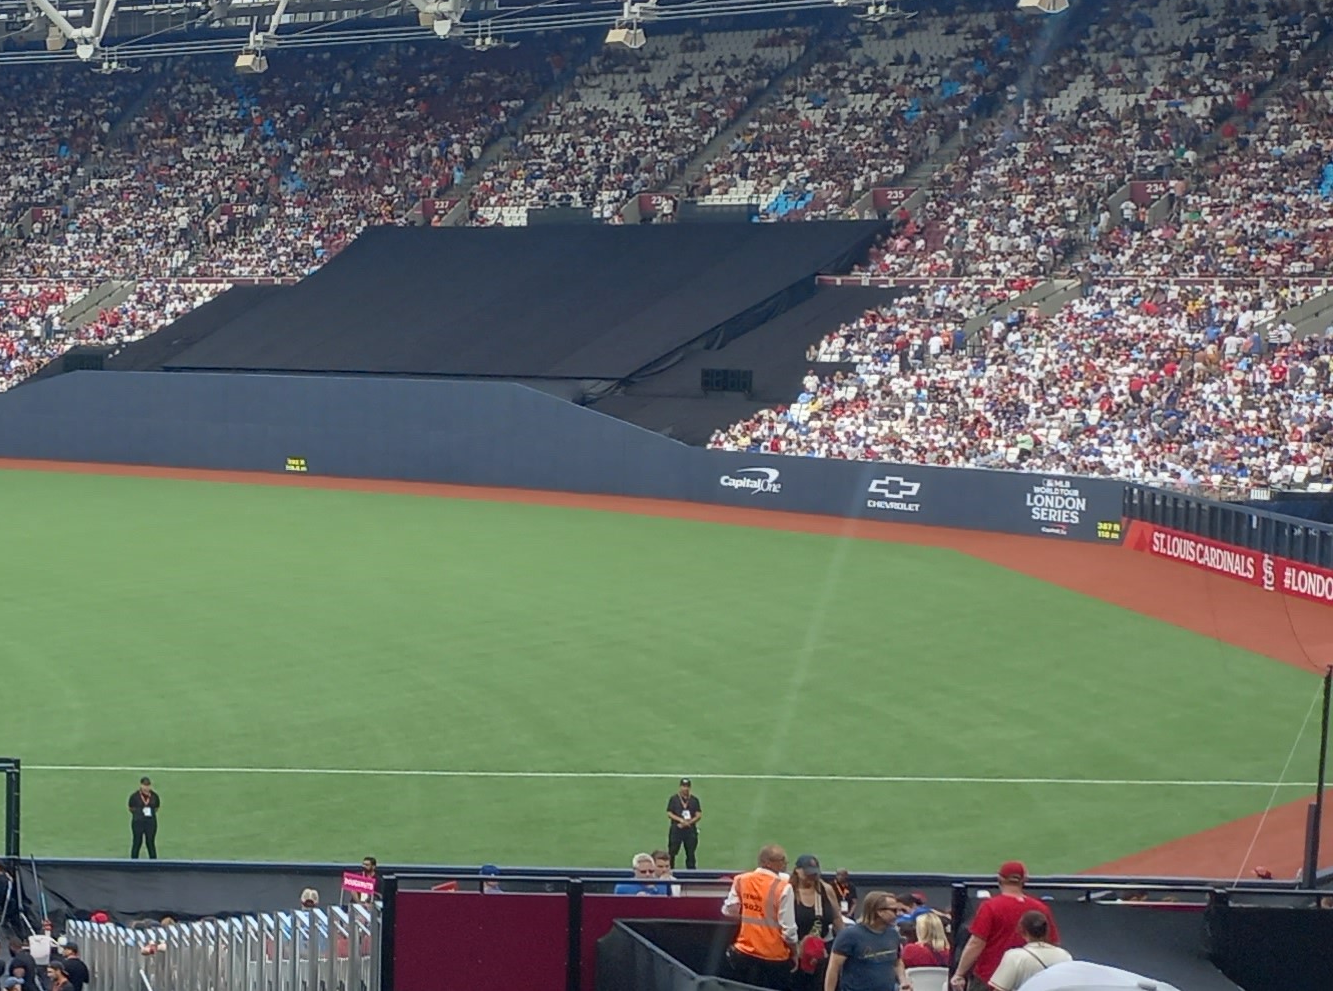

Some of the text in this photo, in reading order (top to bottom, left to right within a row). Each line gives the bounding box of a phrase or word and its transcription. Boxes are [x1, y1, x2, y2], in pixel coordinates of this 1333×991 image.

[887, 190, 904, 199] 235
[1146, 183, 1165, 193] 234
[867, 499, 921, 512] CHEVROLET
[1026, 493, 1086, 511] LONDON
[1031, 507, 1080, 524] SERIES
[1152, 531, 1166, 553] ST.
[1167, 538, 1196, 561] LOUIS
[1196, 543, 1255, 579] CARDINALS
